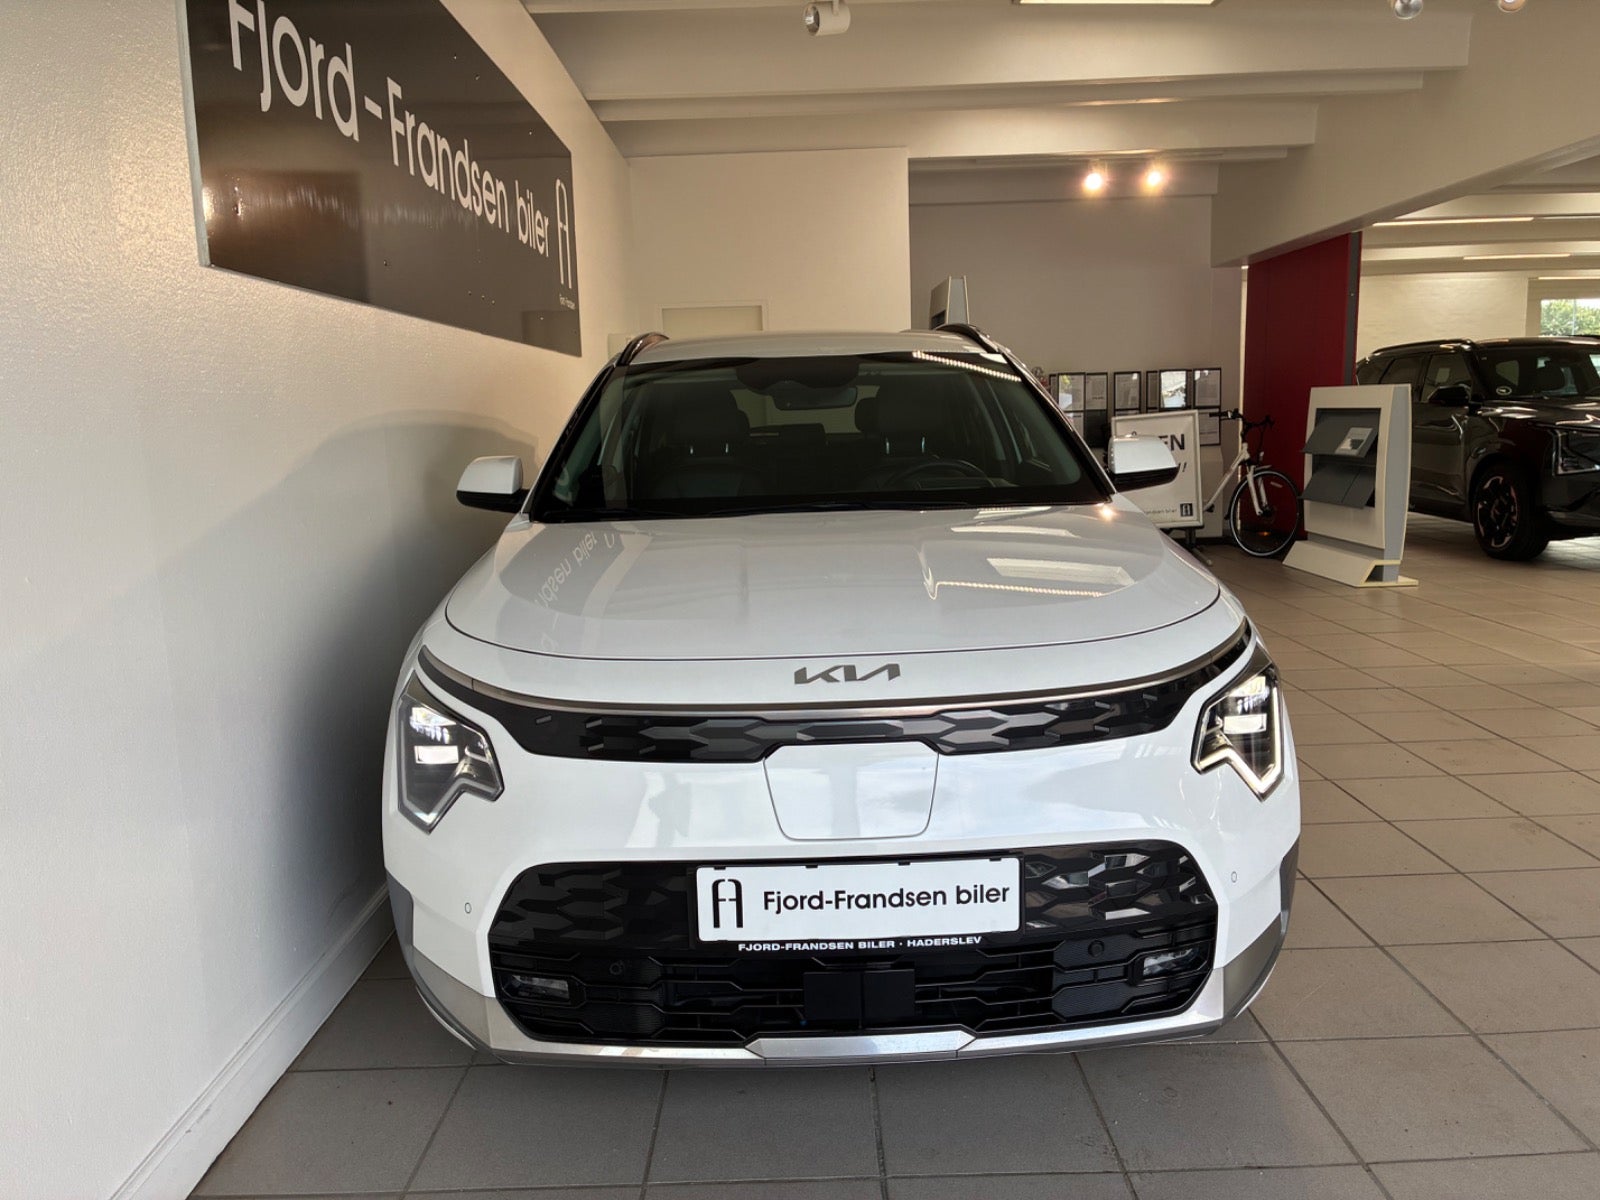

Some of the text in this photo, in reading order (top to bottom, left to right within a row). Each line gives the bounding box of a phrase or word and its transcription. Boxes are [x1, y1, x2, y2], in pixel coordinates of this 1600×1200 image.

[515, 179, 549, 258] biler
[794, 663, 901, 685] KIA
[763, 887, 947, 915] Fjord-Frandsen
[956, 884, 1010, 905] biler
[738, 936, 982, 952] FJORD-FRANDSEN BILER HADERSLEV
